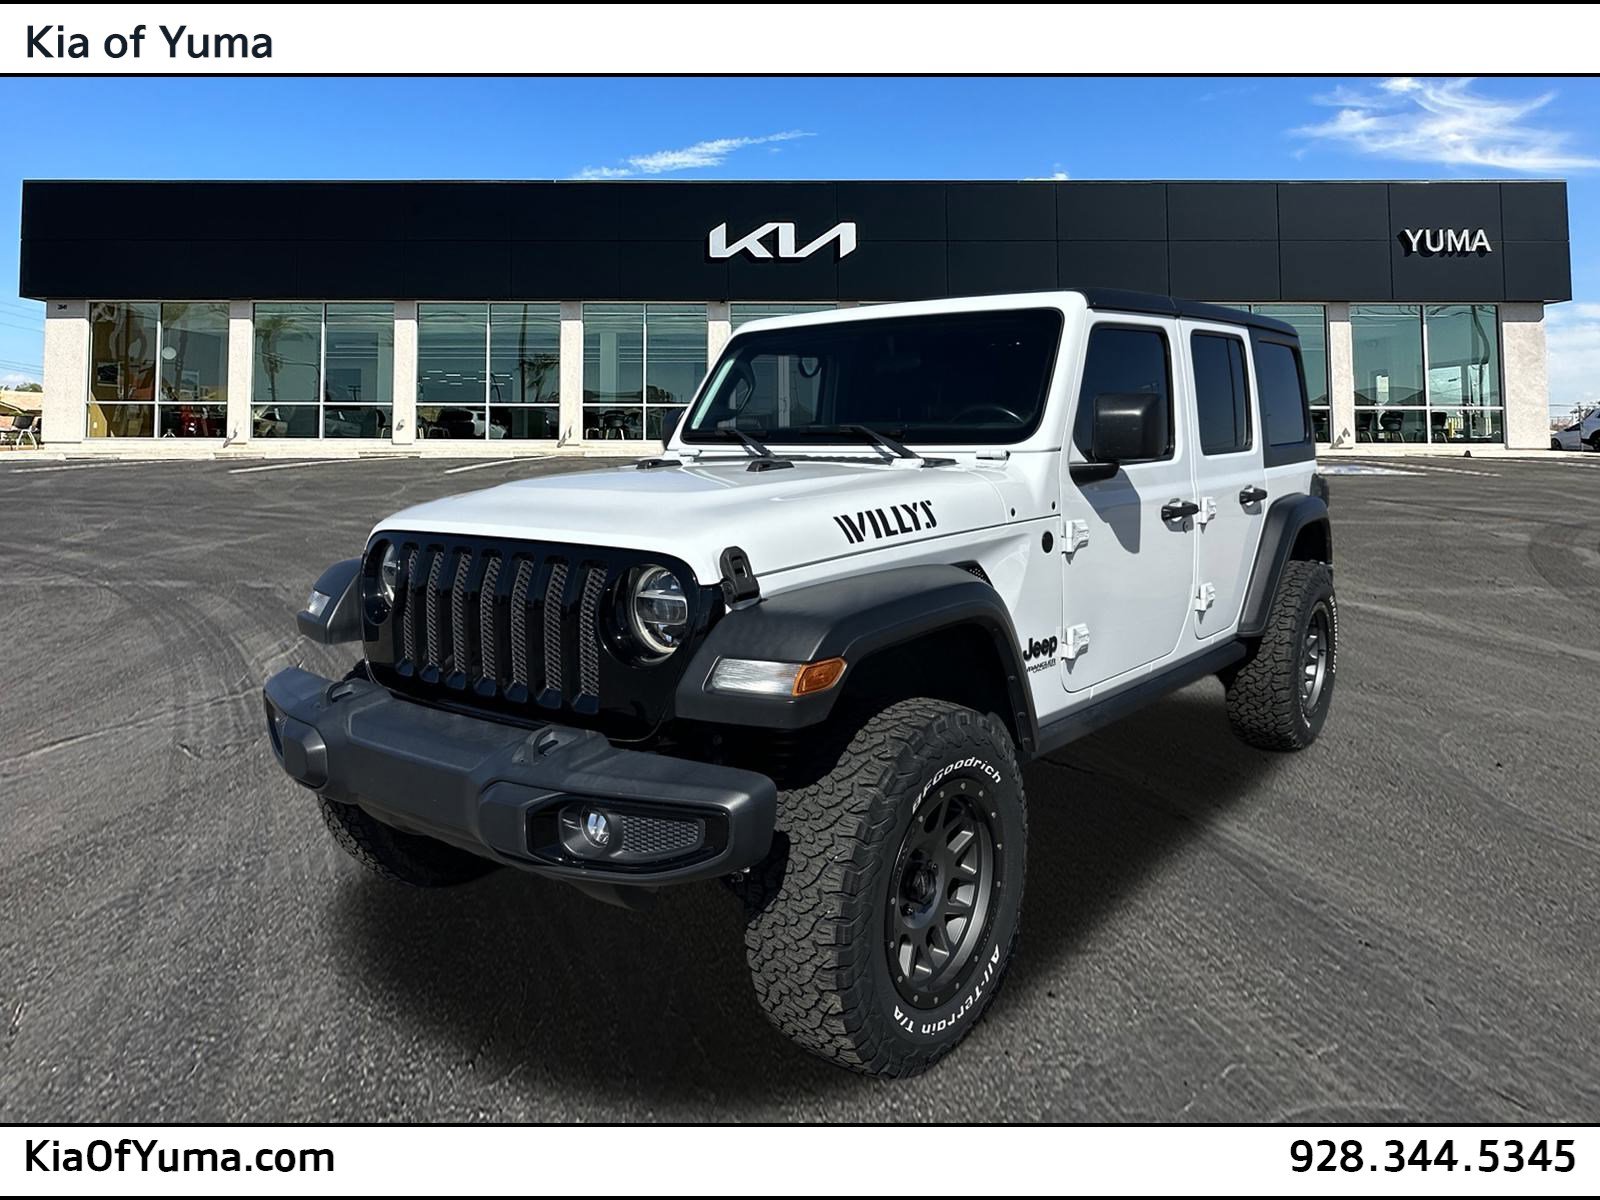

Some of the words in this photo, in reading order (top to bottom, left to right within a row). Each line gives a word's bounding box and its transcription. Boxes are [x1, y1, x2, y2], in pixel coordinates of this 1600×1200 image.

[709, 222, 857, 259] KIA
[1404, 228, 1493, 253] YUMA
[832, 499, 938, 545] WILLYS
[1022, 635, 1058, 661] Jeep
[921, 943, 1001, 1036] All-Terrain
[893, 1004, 915, 1034] T/A
